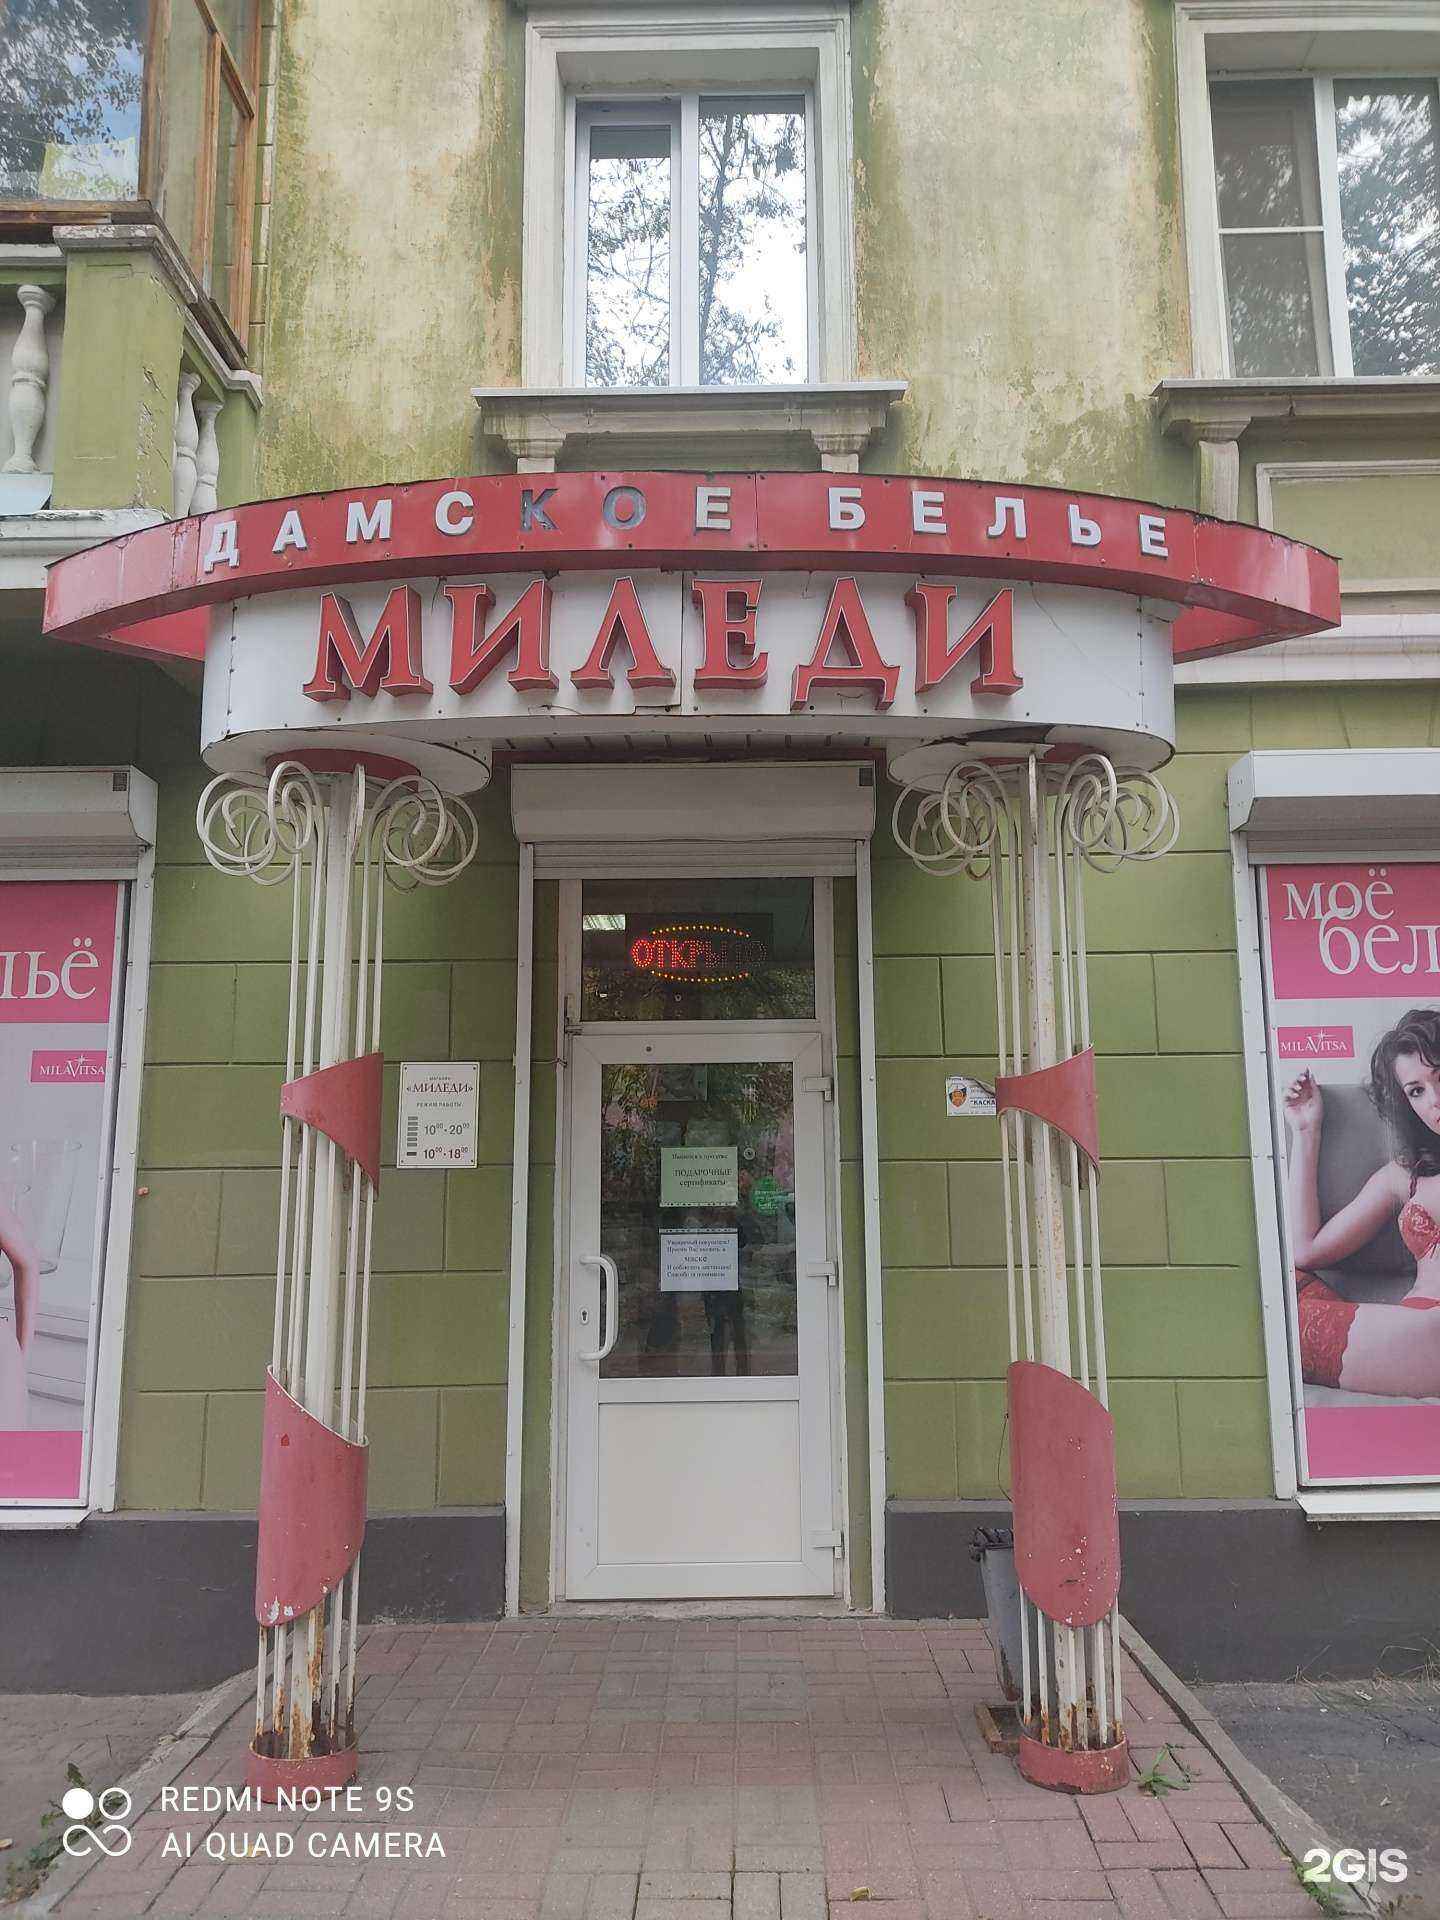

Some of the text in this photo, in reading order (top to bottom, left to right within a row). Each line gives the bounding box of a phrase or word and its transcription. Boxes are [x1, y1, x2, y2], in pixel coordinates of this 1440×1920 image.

[203, 484, 1169, 574] ДАМСКОЕ БЕЛЬЕ
[302, 574, 1024, 712] МИЛЕДИ
[406, 1082, 474, 1095] «МИЛЕДИ»
